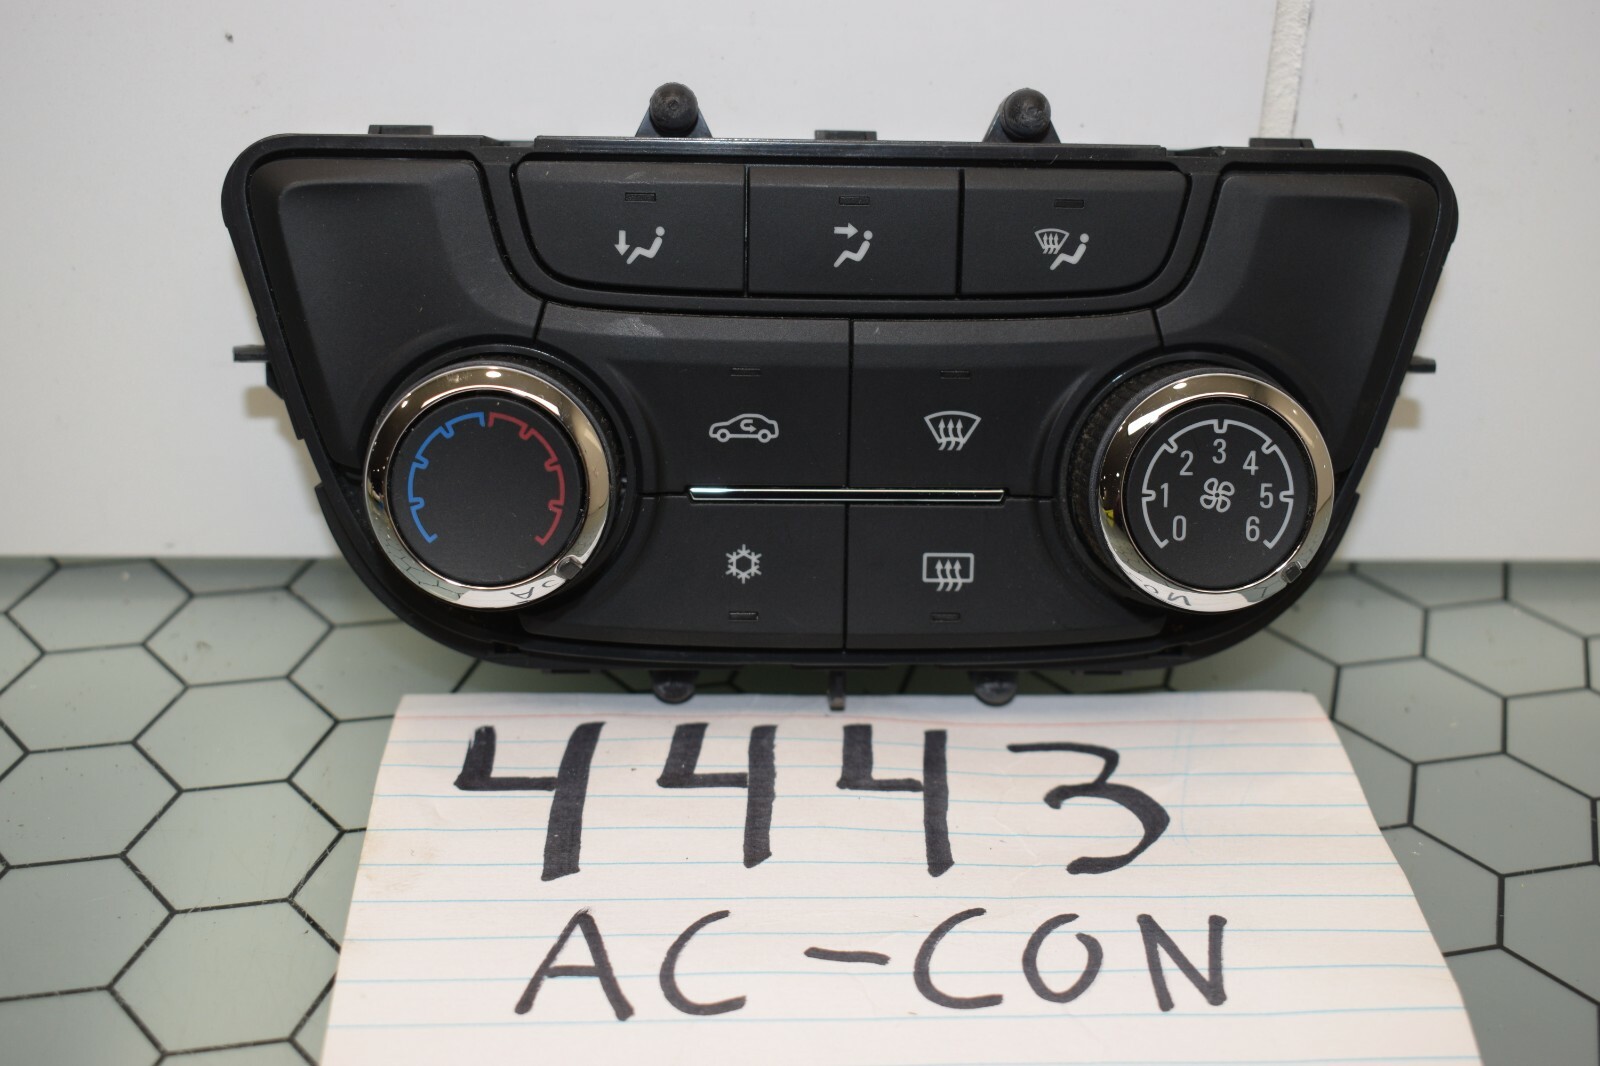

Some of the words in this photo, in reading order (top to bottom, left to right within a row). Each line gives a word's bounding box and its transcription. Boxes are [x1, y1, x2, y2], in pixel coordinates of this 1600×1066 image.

[1179, 450, 1194, 476] 2
[1212, 438, 1227, 464] 3
[1242, 450, 1259, 476] 4
[1159, 482, 1169, 508] 1
[1259, 482, 1274, 509] 5
[1172, 515, 1187, 542] 0
[1245, 515, 1261, 542] 6
[453, 721, 1170, 881] 4443
